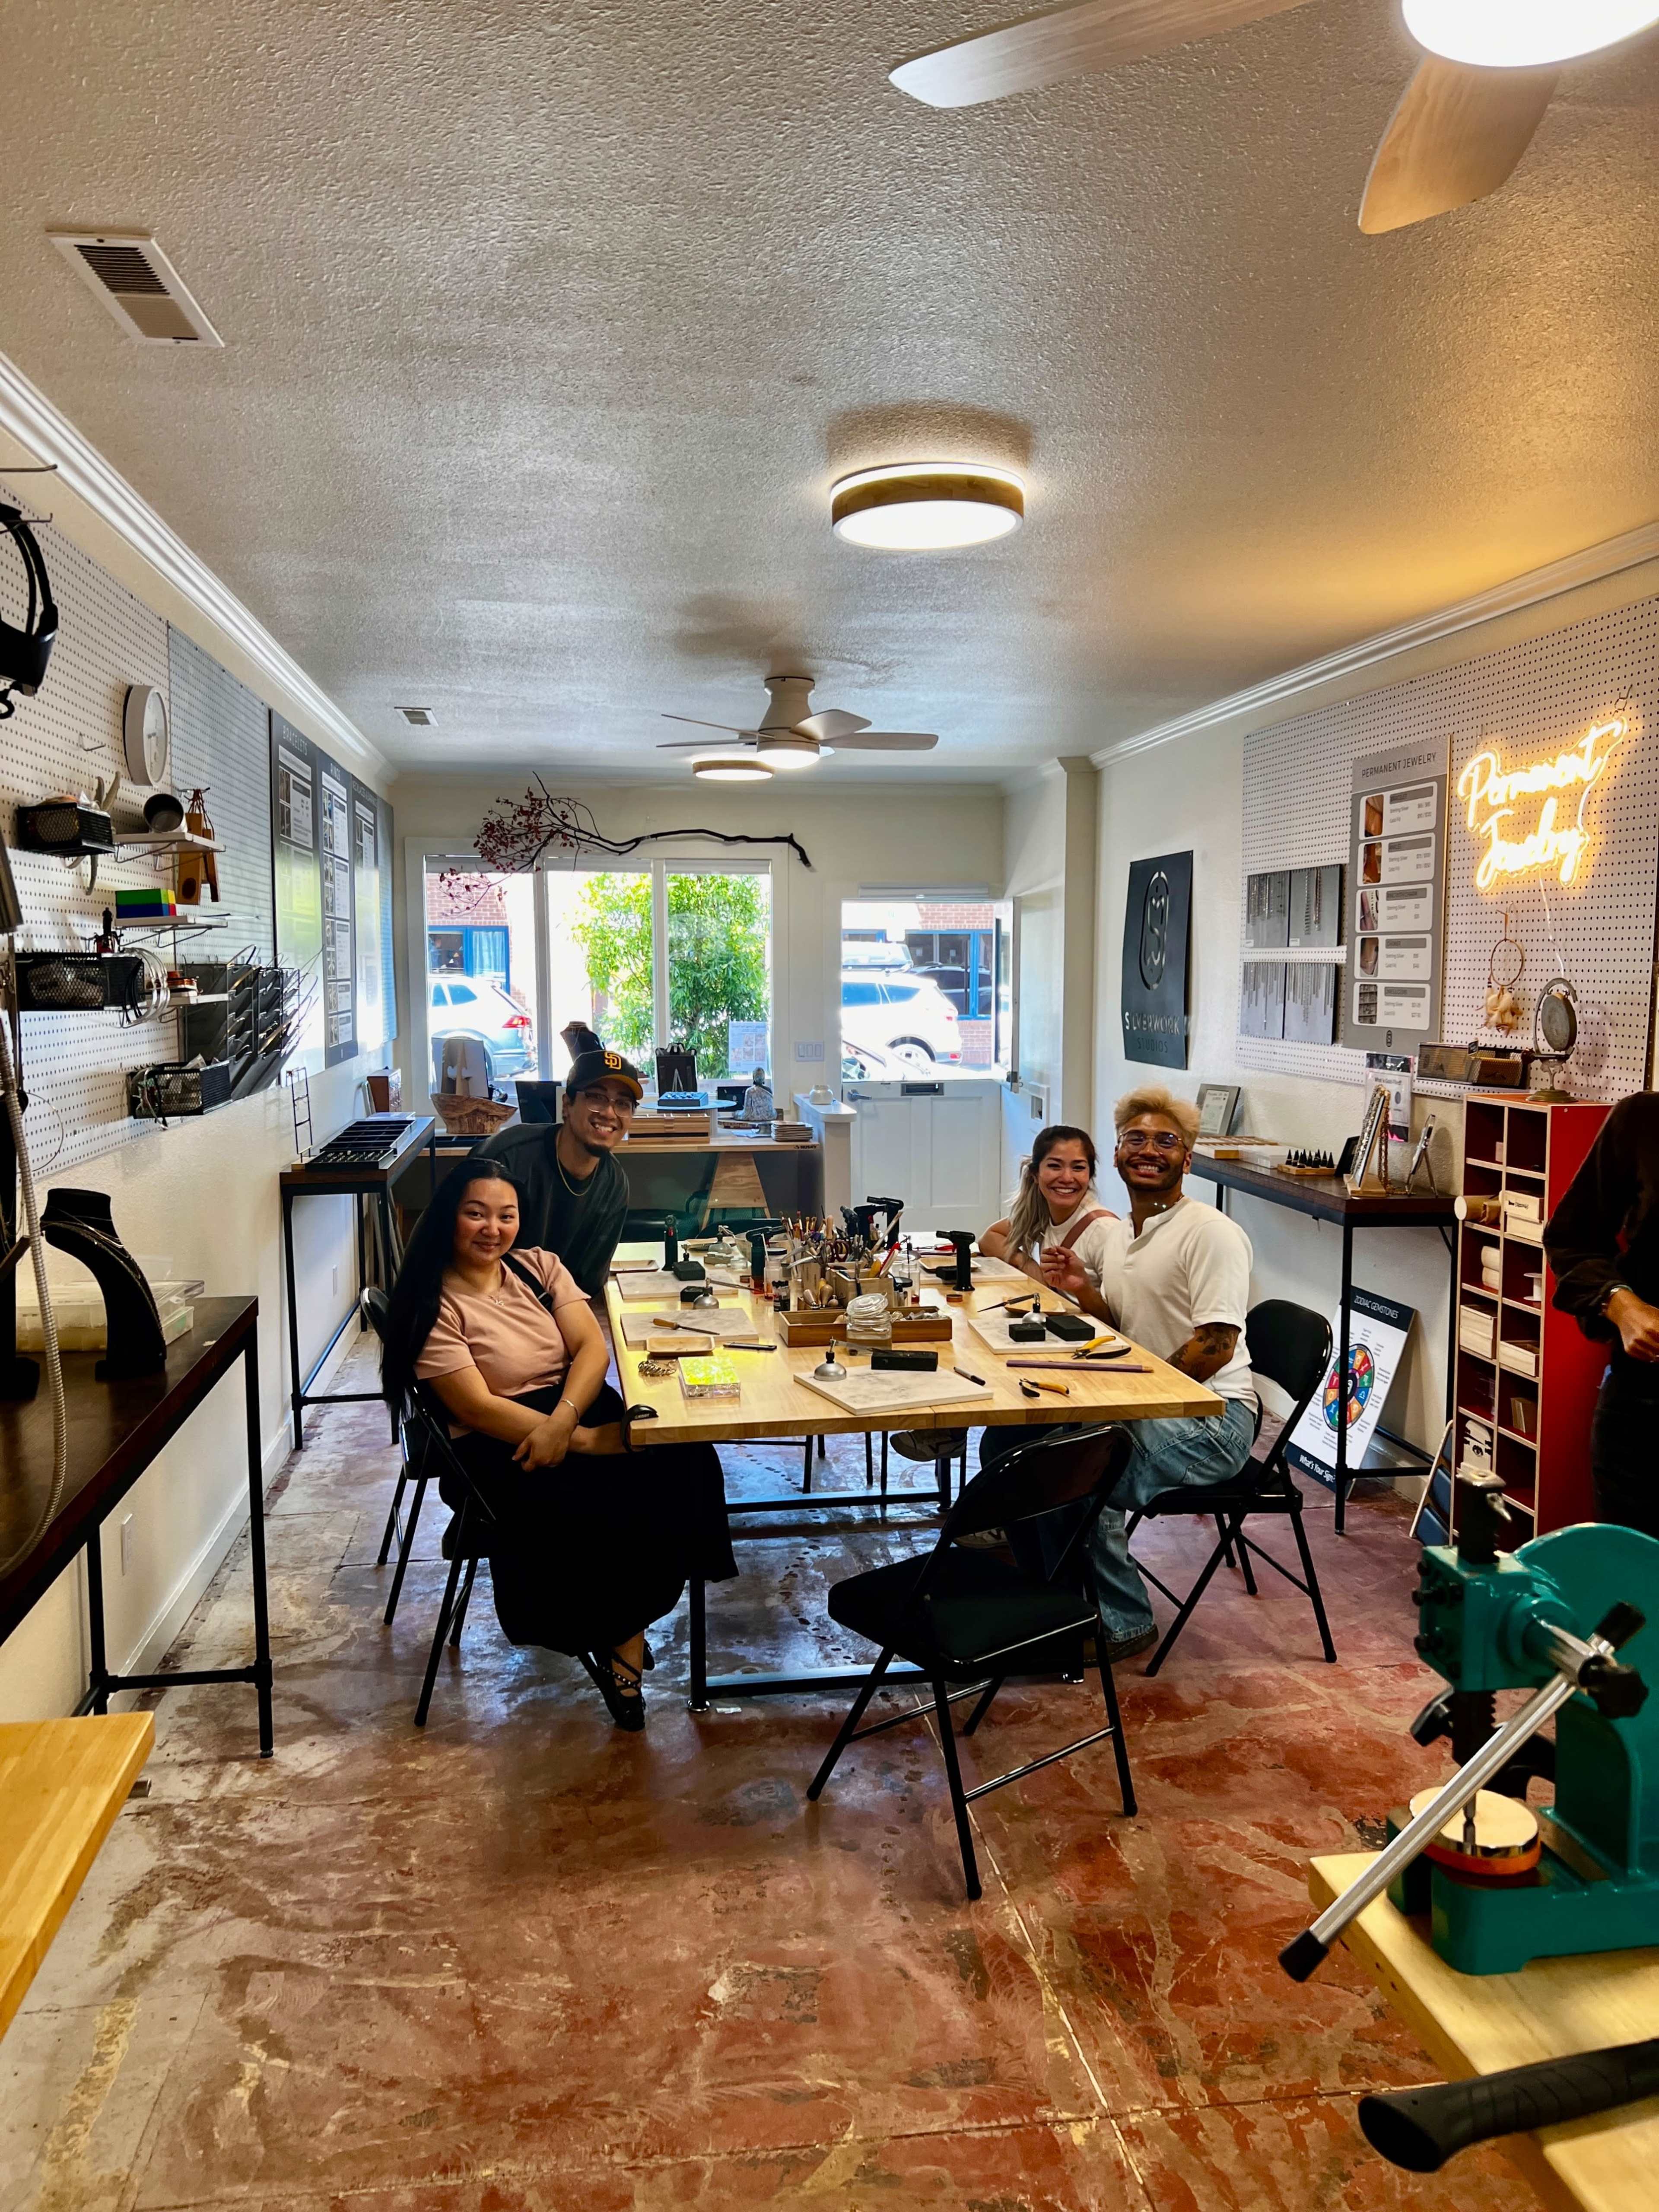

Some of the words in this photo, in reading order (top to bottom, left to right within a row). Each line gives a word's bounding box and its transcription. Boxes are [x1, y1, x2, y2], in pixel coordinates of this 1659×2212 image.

[283, 725, 308, 756] BRACELETS
[1362, 760, 1401, 778] PERMANENT
[1403, 752, 1437, 769] JEWELRY
[1125, 1011, 1180, 1036] SILVERWORK
[1137, 1037, 1168, 1053] STUDIOS
[1354, 1295, 1372, 1309] ZODIAC
[1370, 1302, 1399, 1319] GEMSTONES
[1299, 1454, 1314, 1470] What's
[1314, 1463, 1325, 1475] Your
